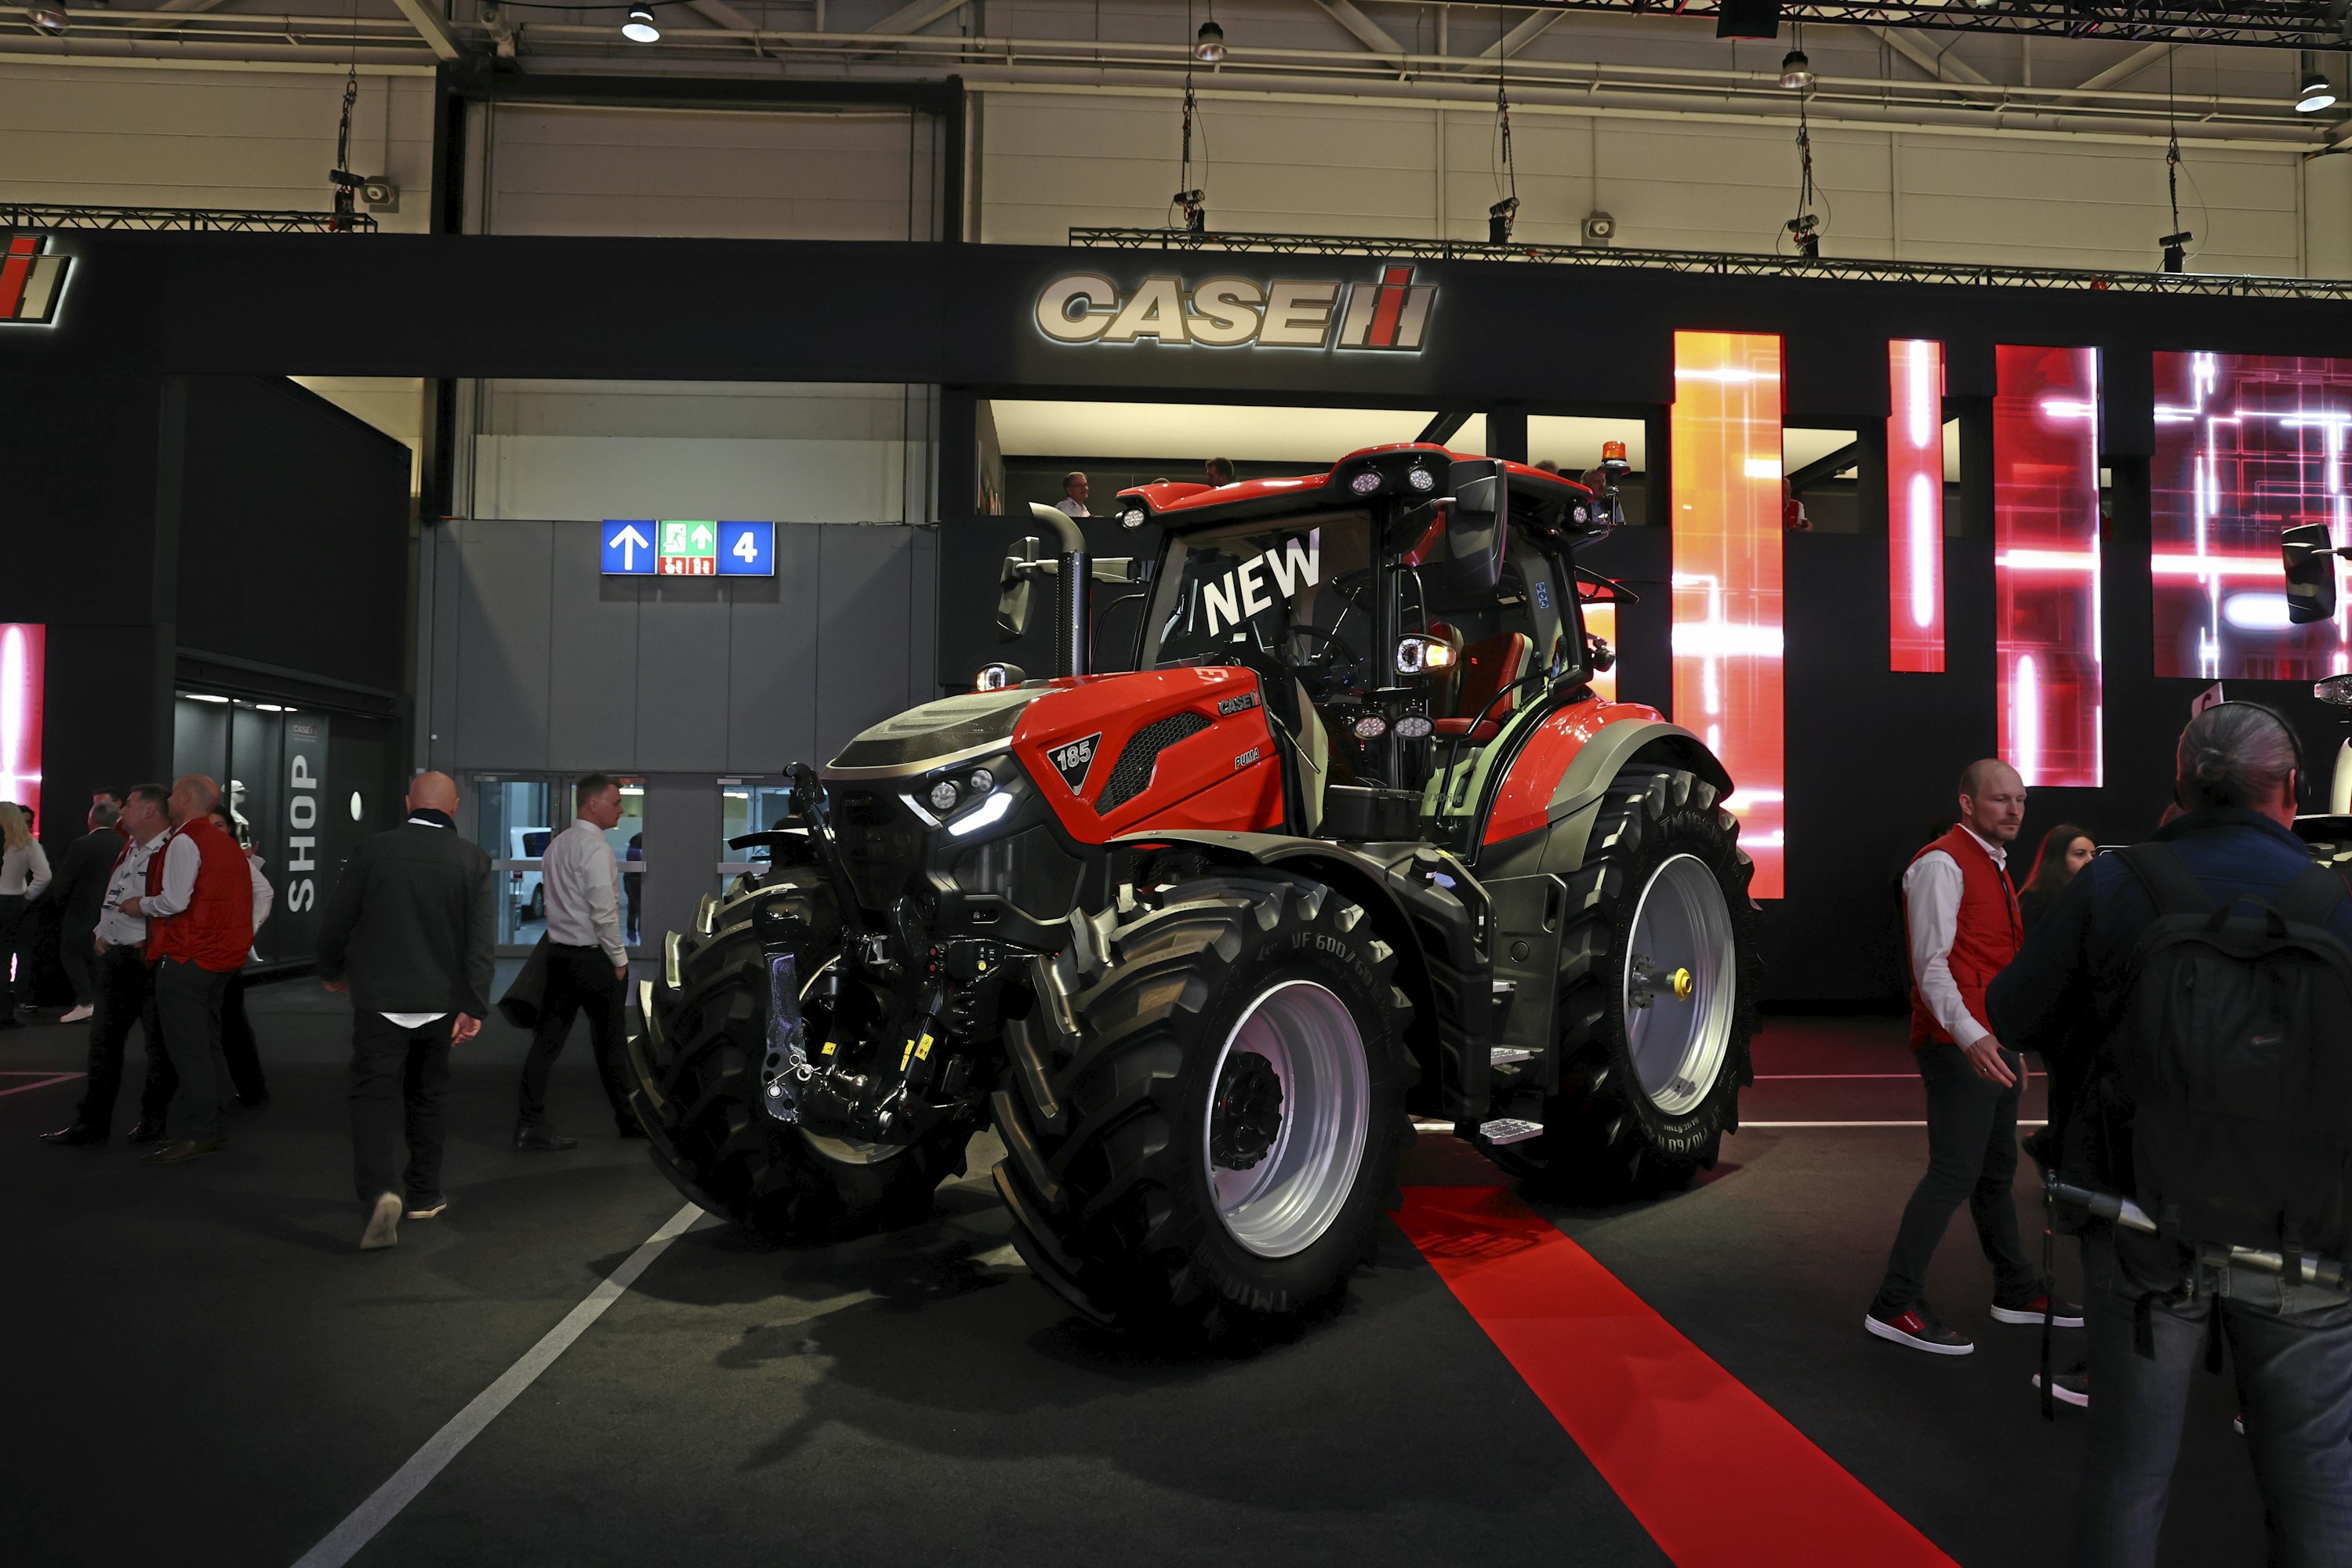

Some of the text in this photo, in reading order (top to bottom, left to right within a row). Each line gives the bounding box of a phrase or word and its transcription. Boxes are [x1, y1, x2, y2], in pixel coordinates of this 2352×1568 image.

[1034, 272, 1341, 347] CASE
[732, 532, 757, 563] 4
[1203, 526, 1320, 637] NEW
[1218, 693, 1251, 715] CASE
[1057, 741, 1091, 771] 185
[1235, 747, 1260, 769] PUMA
[288, 755, 318, 913] SHOP
[1292, 931, 1312, 949] VF
